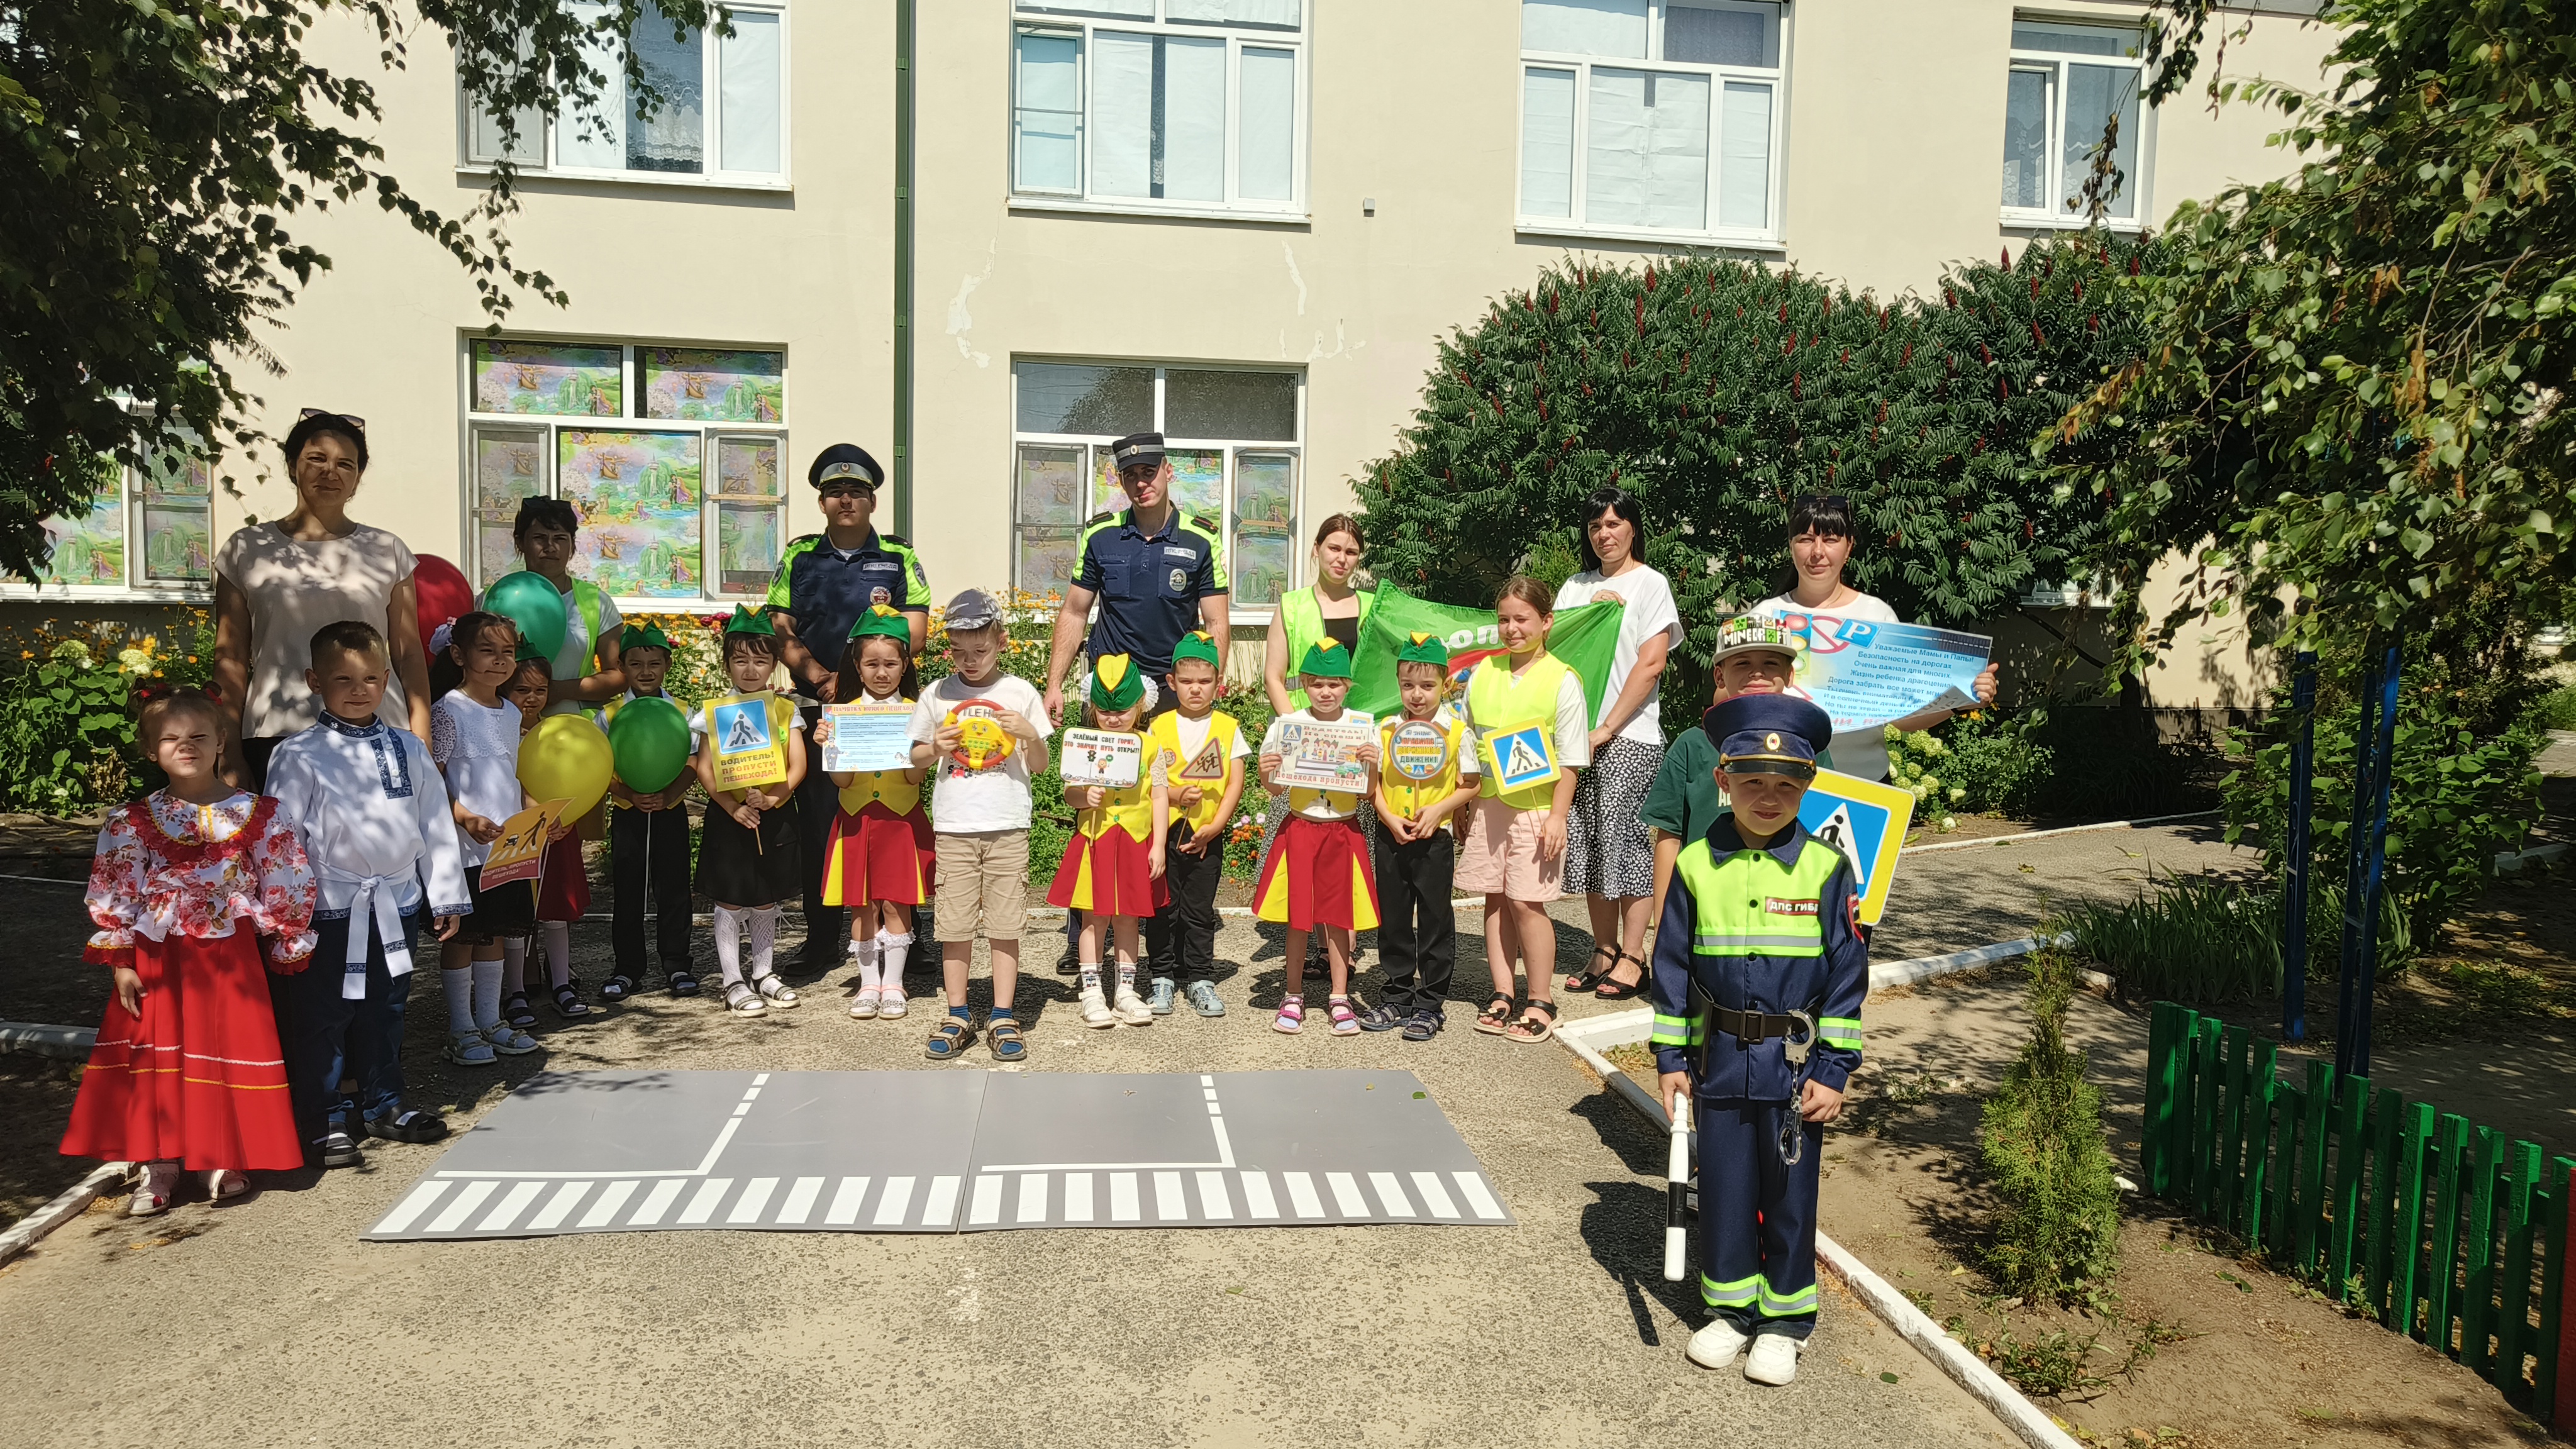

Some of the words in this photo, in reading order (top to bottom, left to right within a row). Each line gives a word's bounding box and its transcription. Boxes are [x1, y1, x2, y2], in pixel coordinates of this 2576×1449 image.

[1858, 651, 1909, 663] Безопасность
[1921, 660, 1951, 669] дорогах
[1875, 643, 1918, 655] Уважаемые
[1919, 648, 1942, 658] Мамы
[1950, 653, 1974, 663] Папы!
[1850, 669, 1874, 678] Жизнь
[1875, 674, 1906, 682] ребенка
[1854, 660, 1877, 669] Очень
[1879, 664, 1906, 672] важная
[1924, 670, 1951, 679] многих.
[1828, 676, 1854, 686] Дорога
[1855, 680, 1885, 689] забрать
[1072, 733, 1098, 741] ЗЕЛЁНЫЙ
[721, 751, 775, 766] ВОДИТЕЛЬ!
[722, 760, 776, 775] ПРОПУСТИ
[723, 768, 777, 783] ПЕШЕХОДА!
[1275, 770, 1316, 782] Пешехода
[1320, 777, 1363, 787] пропусти!
[1770, 901, 1792, 911] ДПС
